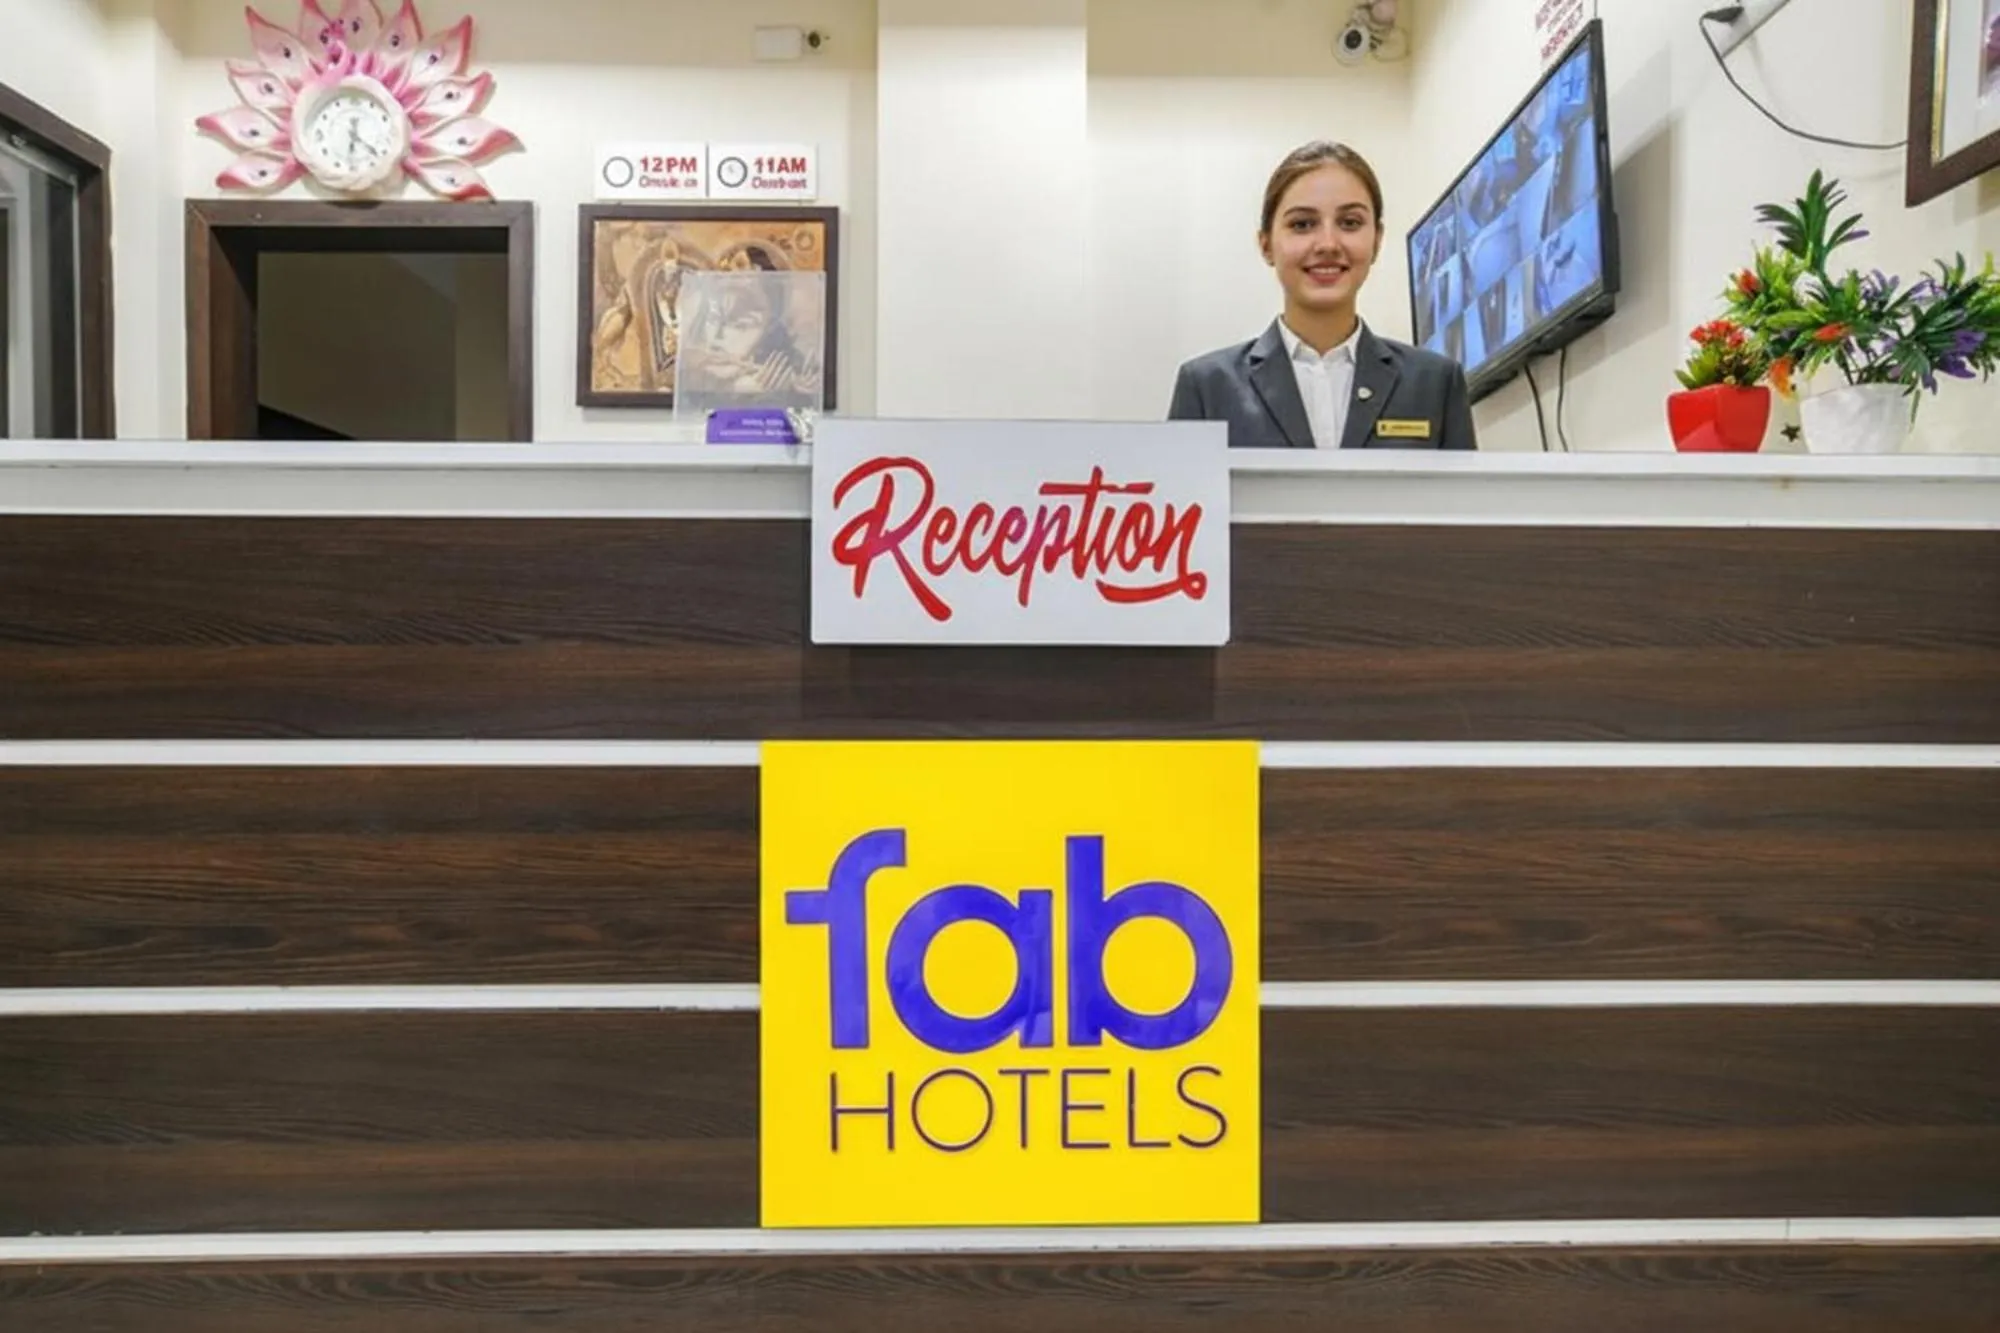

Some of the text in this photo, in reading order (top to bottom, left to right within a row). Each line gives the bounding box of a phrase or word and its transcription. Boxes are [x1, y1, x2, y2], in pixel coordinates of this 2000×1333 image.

[832, 456, 1207, 621] Reception
[785, 828, 1233, 1054] fab
[830, 1066, 1228, 1153] HOTELS
